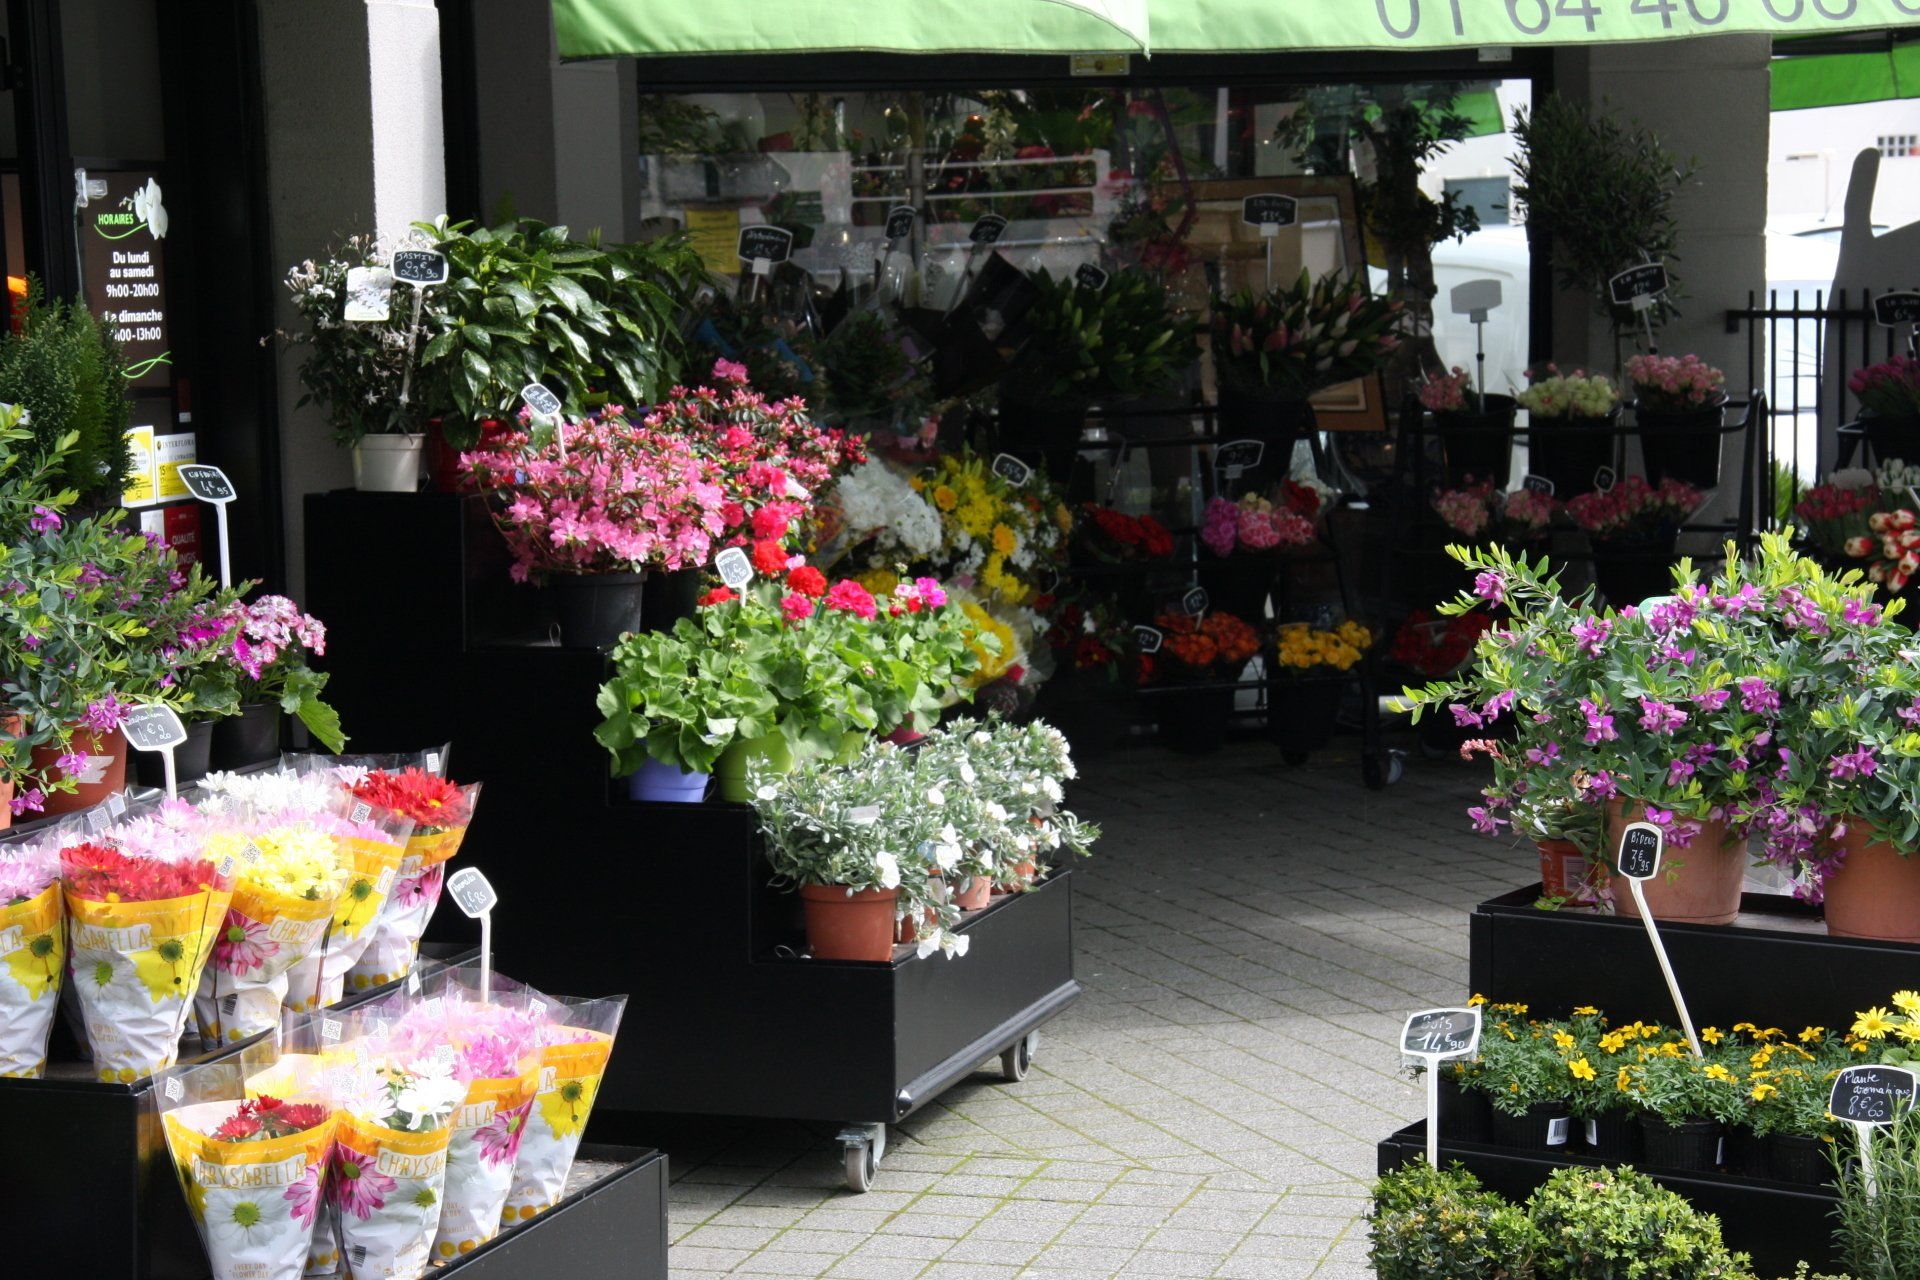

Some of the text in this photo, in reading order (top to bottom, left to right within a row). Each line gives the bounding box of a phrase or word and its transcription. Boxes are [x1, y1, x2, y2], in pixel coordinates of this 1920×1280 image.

[98, 213, 134, 225] HORAIRES
[112, 251, 150, 264] Du lundi
[396, 252, 437, 263] JASMIN
[110, 265, 155, 279] au samedi
[118, 309, 164, 323] dimanche
[1843, 1069, 1881, 1084] Plante
[193, 1157, 306, 1187] CHRYSABELLA
